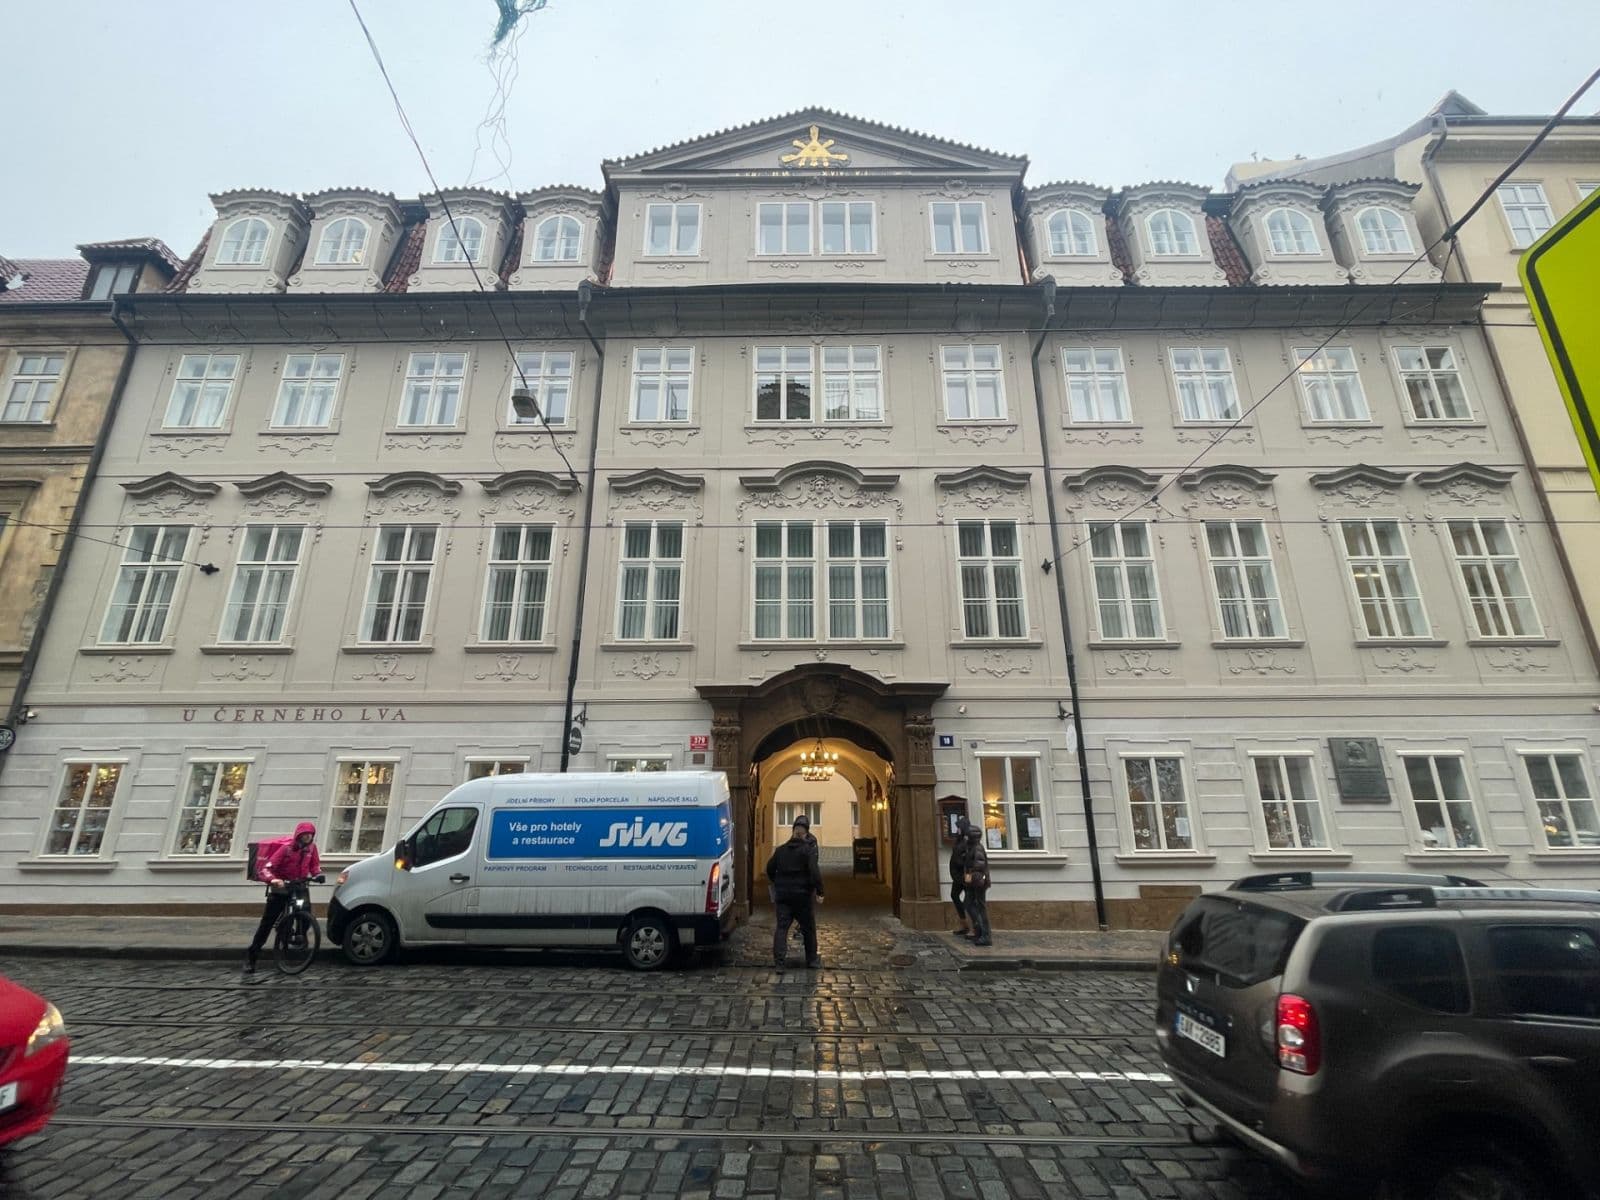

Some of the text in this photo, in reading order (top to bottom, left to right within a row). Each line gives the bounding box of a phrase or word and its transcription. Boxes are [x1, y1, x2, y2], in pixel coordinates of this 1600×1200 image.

[183, 708, 196, 722] U
[360, 707, 407, 722] LVA
[509, 821, 582, 833] Vše pro hotely
[512, 835, 576, 845] a restaurace
[515, 863, 547, 872] PROGRAM
[565, 864, 609, 872] TECHNOLOGIE
